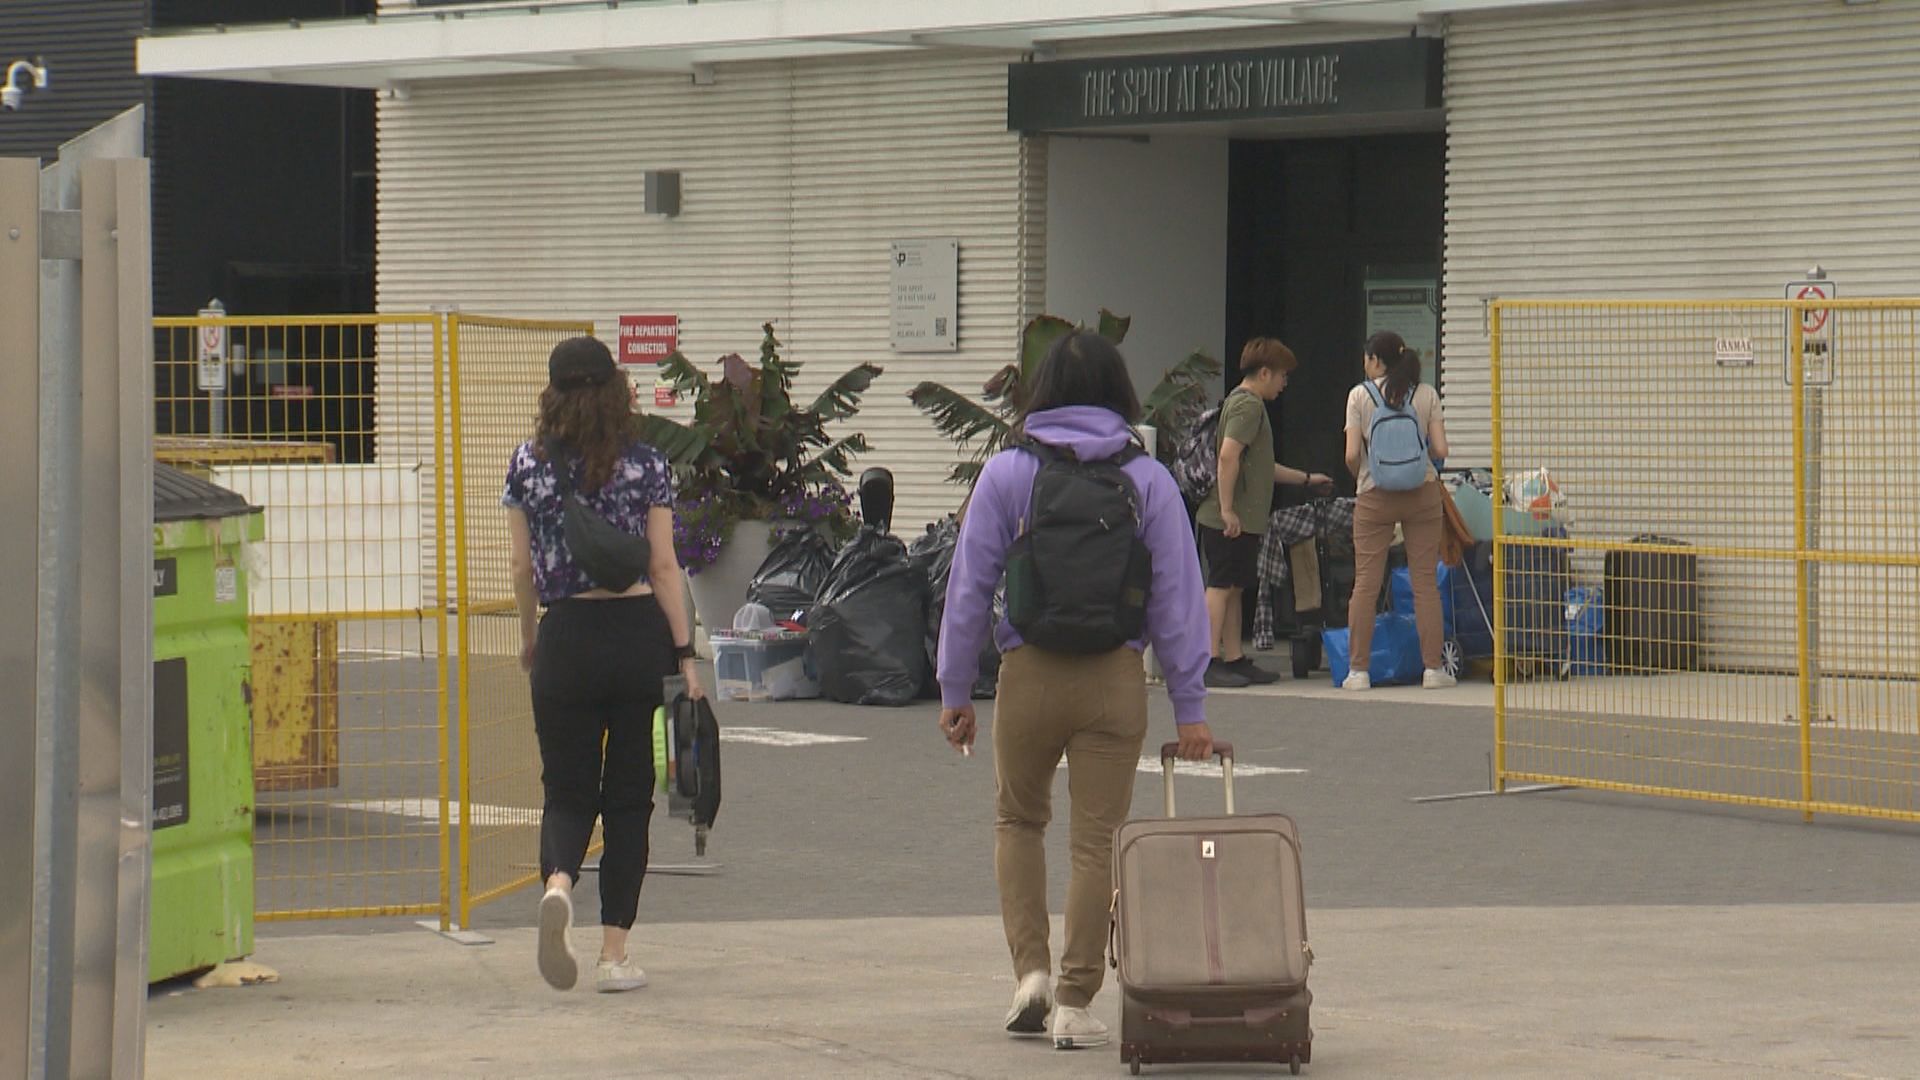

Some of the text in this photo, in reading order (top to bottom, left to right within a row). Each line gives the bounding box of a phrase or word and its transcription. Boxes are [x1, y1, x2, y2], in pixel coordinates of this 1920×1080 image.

[1083, 55, 1340, 117] THE SPOT AT EAST VILLAGE
[620, 325, 676, 336] FIRE DEPARTMENT
[627, 342, 667, 354] CONNECTION
